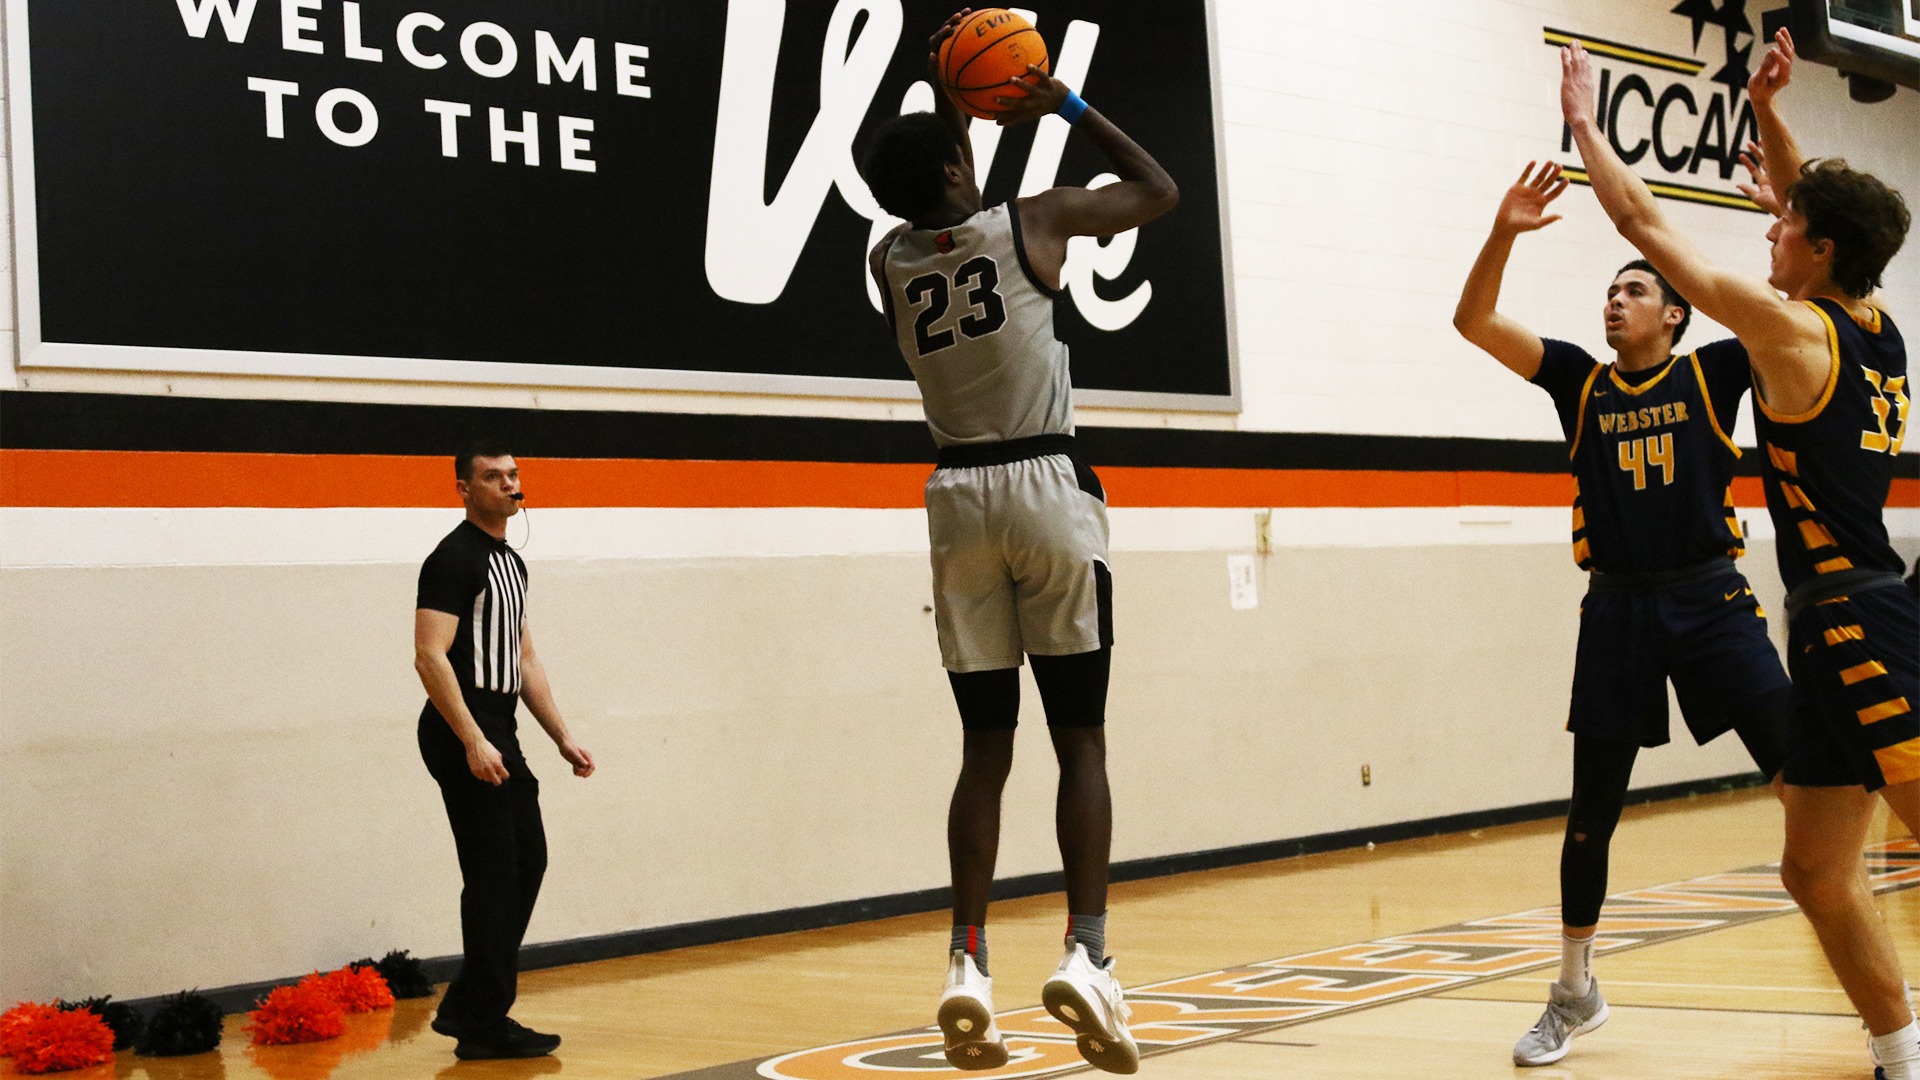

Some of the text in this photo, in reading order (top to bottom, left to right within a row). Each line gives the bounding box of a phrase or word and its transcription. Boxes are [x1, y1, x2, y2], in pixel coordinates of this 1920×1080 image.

[173, 0, 652, 99] WELCOME
[247, 77, 597, 173] TO THE
[904, 255, 1008, 357] 23
[1598, 401, 1690, 434] WEBSTER
[1618, 432, 1675, 491] 44
